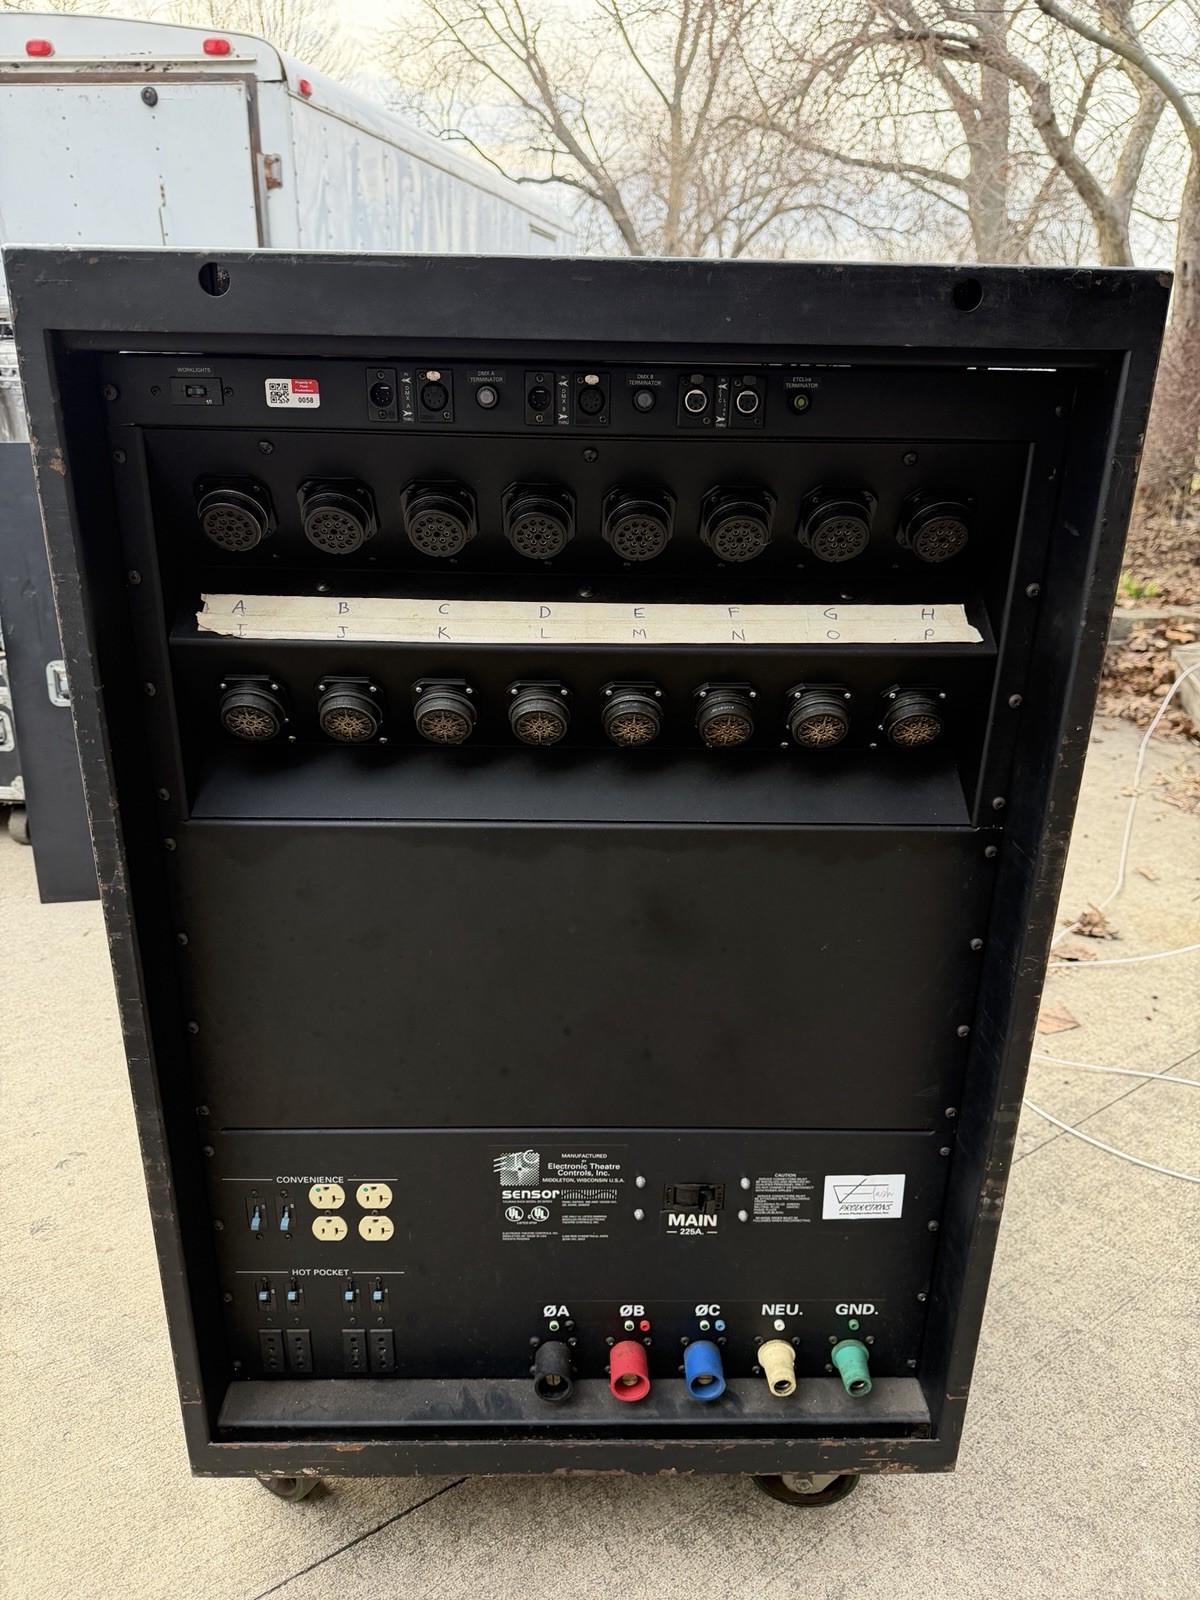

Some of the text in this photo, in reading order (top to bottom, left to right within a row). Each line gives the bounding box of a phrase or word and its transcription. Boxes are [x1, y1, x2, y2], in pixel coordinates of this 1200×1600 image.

[232, 600, 935, 620] A B C D E F G H
[336, 626, 350, 639] J
[437, 626, 451, 639] K
[540, 627, 551, 639] L
[633, 628, 647, 639] M
[732, 629, 745, 642] N
[924, 628, 935, 641] P
[589, 1162, 620, 1170] Theatre
[276, 1176, 344, 1184] CONVENIENCE
[509, 1208, 520, 1219] UL
[535, 1208, 546, 1219] UL
[668, 1213, 717, 1226] MAIN
[761, 1304, 803, 1316] NEU.
[835, 1303, 879, 1315] GND.
